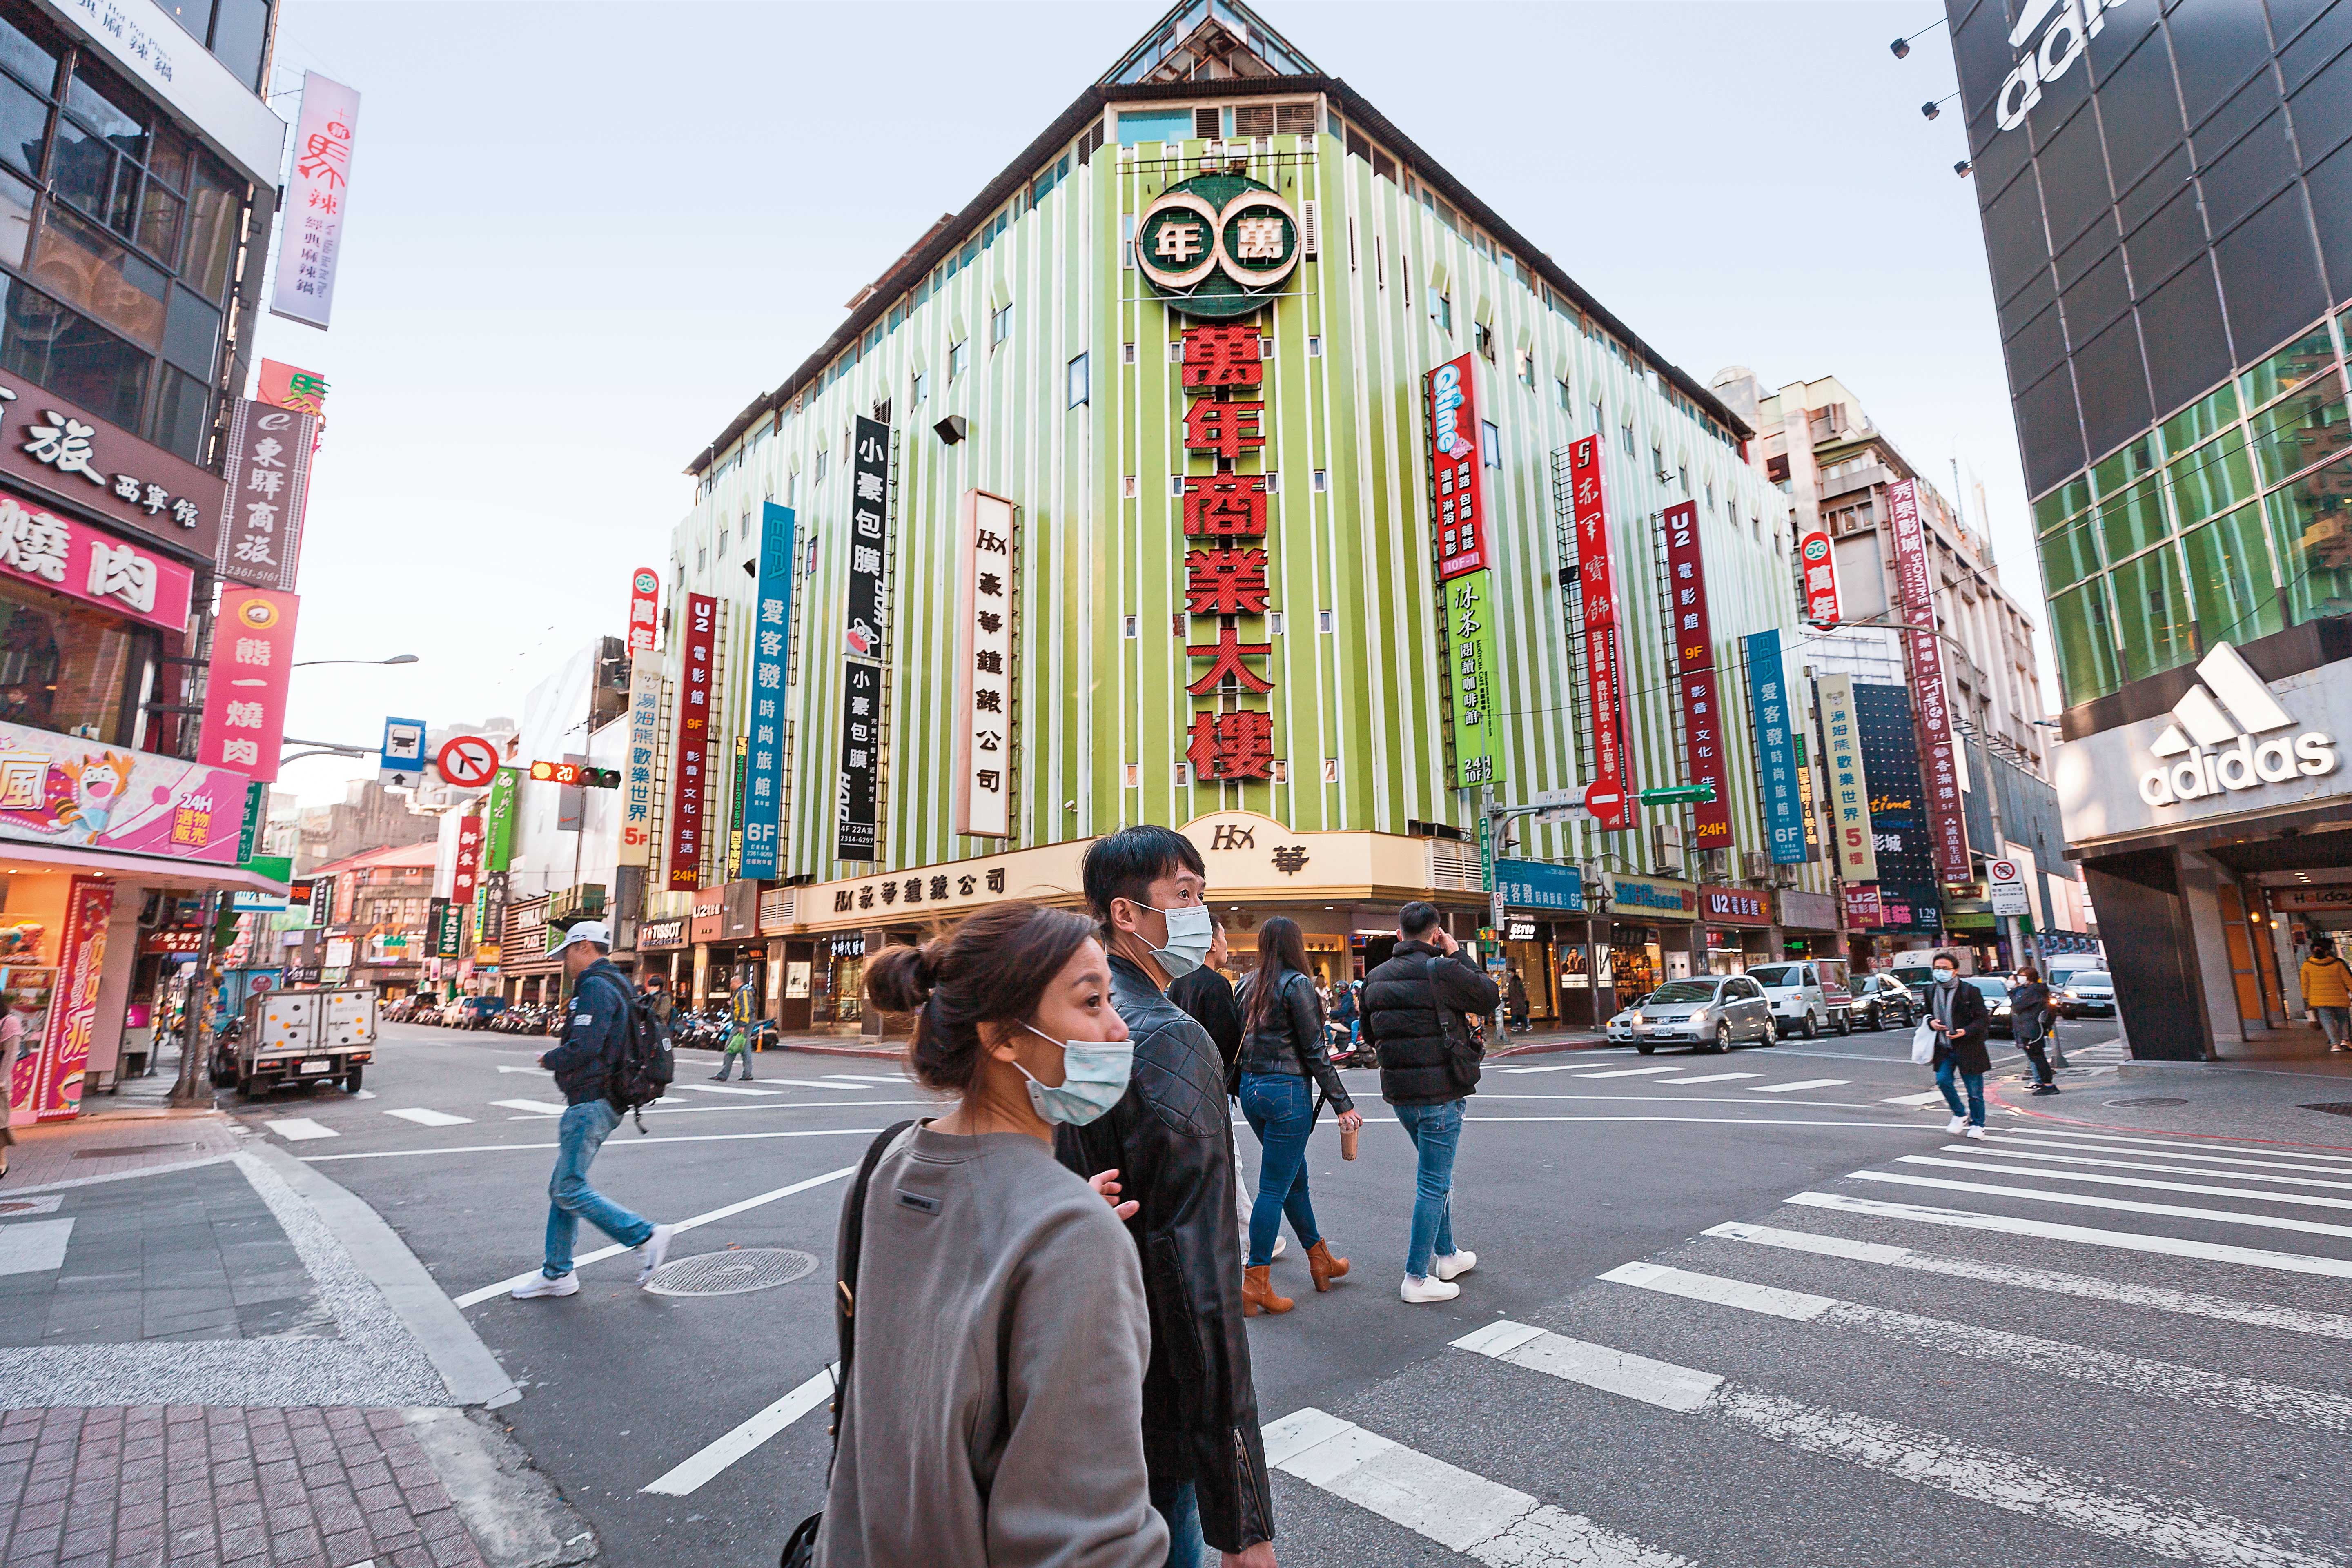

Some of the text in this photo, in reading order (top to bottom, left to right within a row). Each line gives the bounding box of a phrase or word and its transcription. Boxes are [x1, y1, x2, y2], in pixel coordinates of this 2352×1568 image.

[1155, 222, 1201, 262] 年
[115, 474, 200, 529] 西寧館
[235, 438, 287, 567] 東驛商旅
[853, 436, 885, 577] 小豪包膜
[1893, 481, 1921, 553] 秀泰影城
[1181, 324, 1276, 782] 萬年商業大樓
[1444, 529, 1457, 557] 電影
[1672, 512, 1691, 549] U2
[1677, 563, 1699, 631] 電影館
[1911, 552, 1929, 604] SHOWTIME
[629, 598, 655, 651] 萬年
[695, 601, 711, 633] U2
[1684, 645, 1704, 659] 9F
[690, 645, 706, 706] 電影館
[754, 598, 784, 797] 愛客發 時尚旅館
[976, 571, 1004, 792] 豪華鐘錶公司
[1459, 641, 1479, 727] 閱讀咖啡館
[221, 636, 272, 766] 熊一燒肉
[686, 717, 704, 730] 9F
[849, 670, 870, 769] 小豪包膜
[1760, 682, 1784, 746] 愛客發
[556, 766, 574, 782] 20
[629, 692, 657, 822] 湯姆熊歡樂世界
[1830, 711, 1860, 822] 湯姆熊歡樂世界
[2139, 732, 2337, 807] adidas
[181, 792, 213, 811] 24H
[1770, 749, 1789, 816] 時尚旅館
[1869, 795, 1911, 813] time
[176, 808, 210, 829] 選物
[624, 827, 648, 846] 5F
[747, 822, 775, 842] 6F
[1699, 821, 1727, 836] 24H
[1775, 826, 1798, 842] 6F
[672, 869, 697, 882] 24H
[1271, 845, 1310, 876] 華
[1570, 893, 1580, 907] 6F
[1846, 893, 1878, 903] U2
[653, 921, 682, 940] TISSOT
